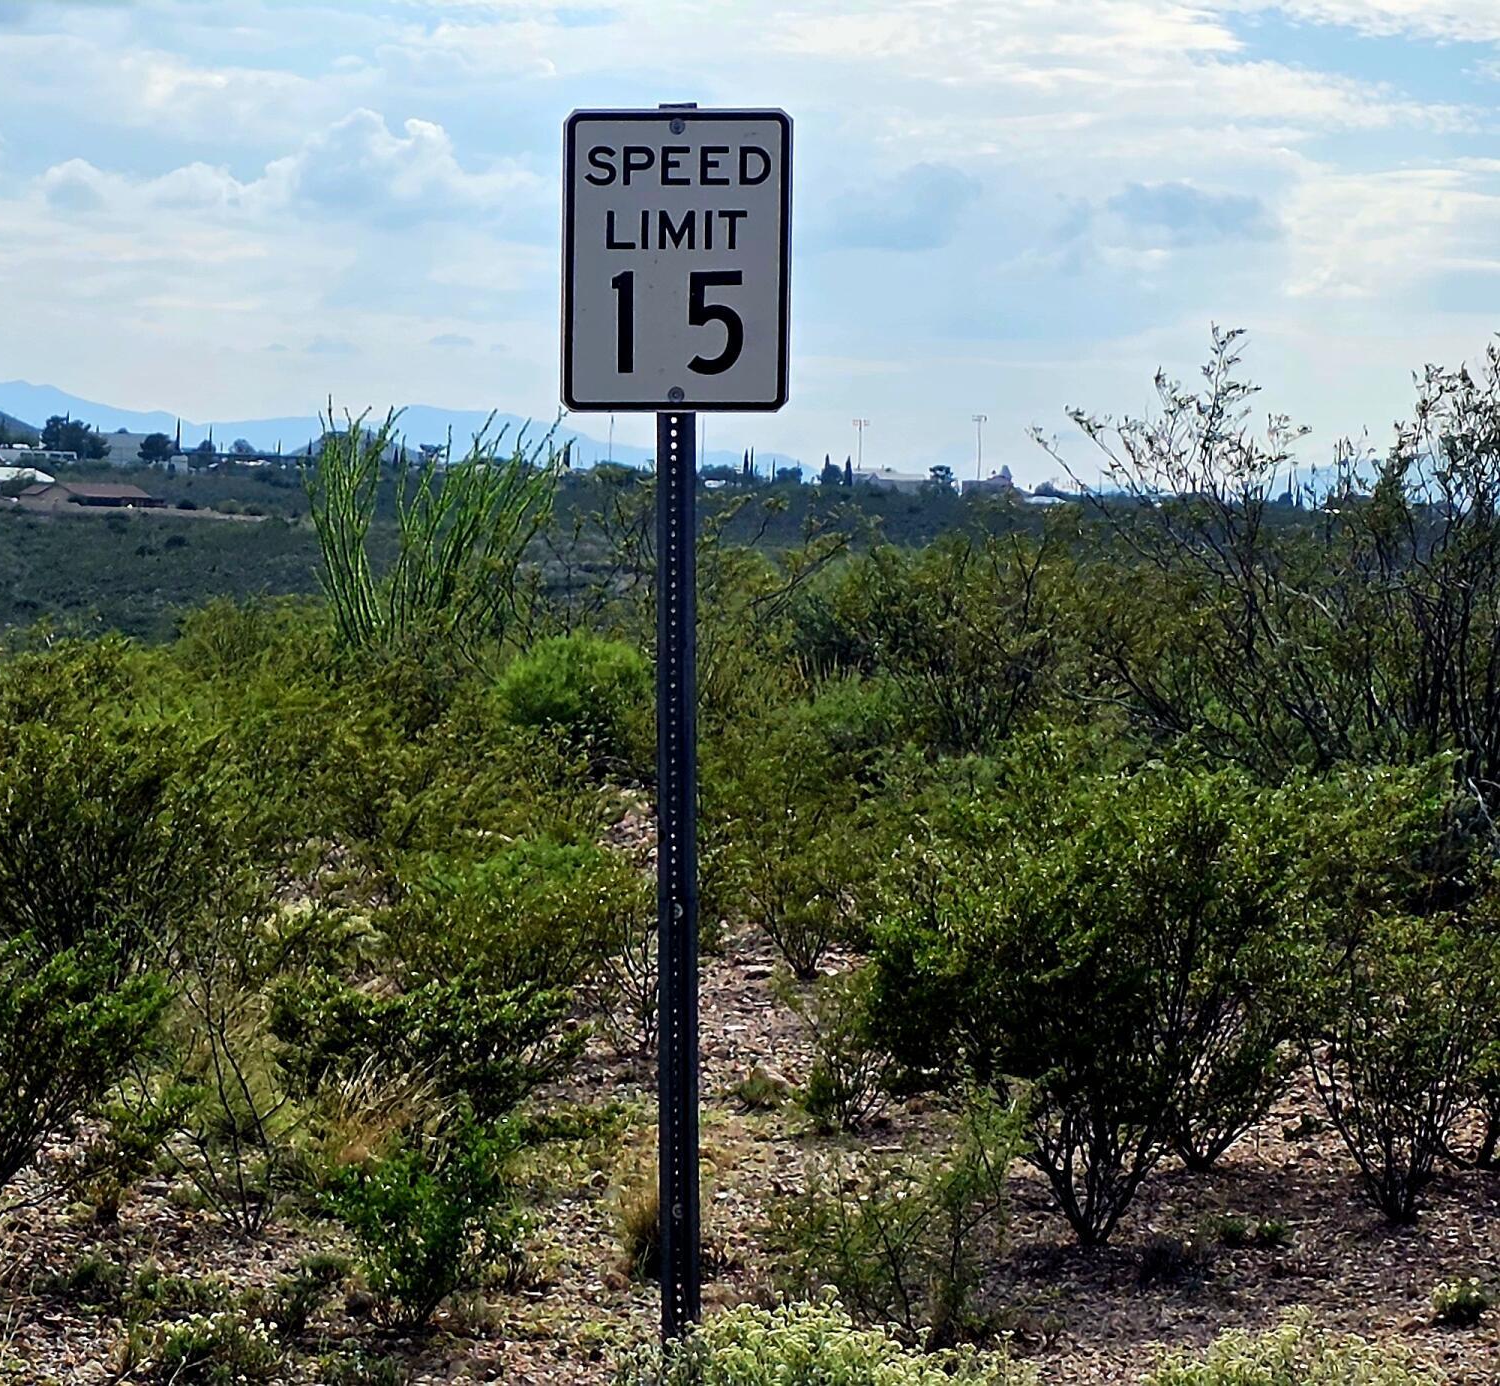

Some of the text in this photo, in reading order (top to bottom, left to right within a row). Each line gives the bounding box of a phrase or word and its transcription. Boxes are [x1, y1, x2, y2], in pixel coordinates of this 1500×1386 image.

[584, 145, 772, 186] SPEED
[605, 210, 748, 250] LIMIT
[611, 270, 745, 376] 15
